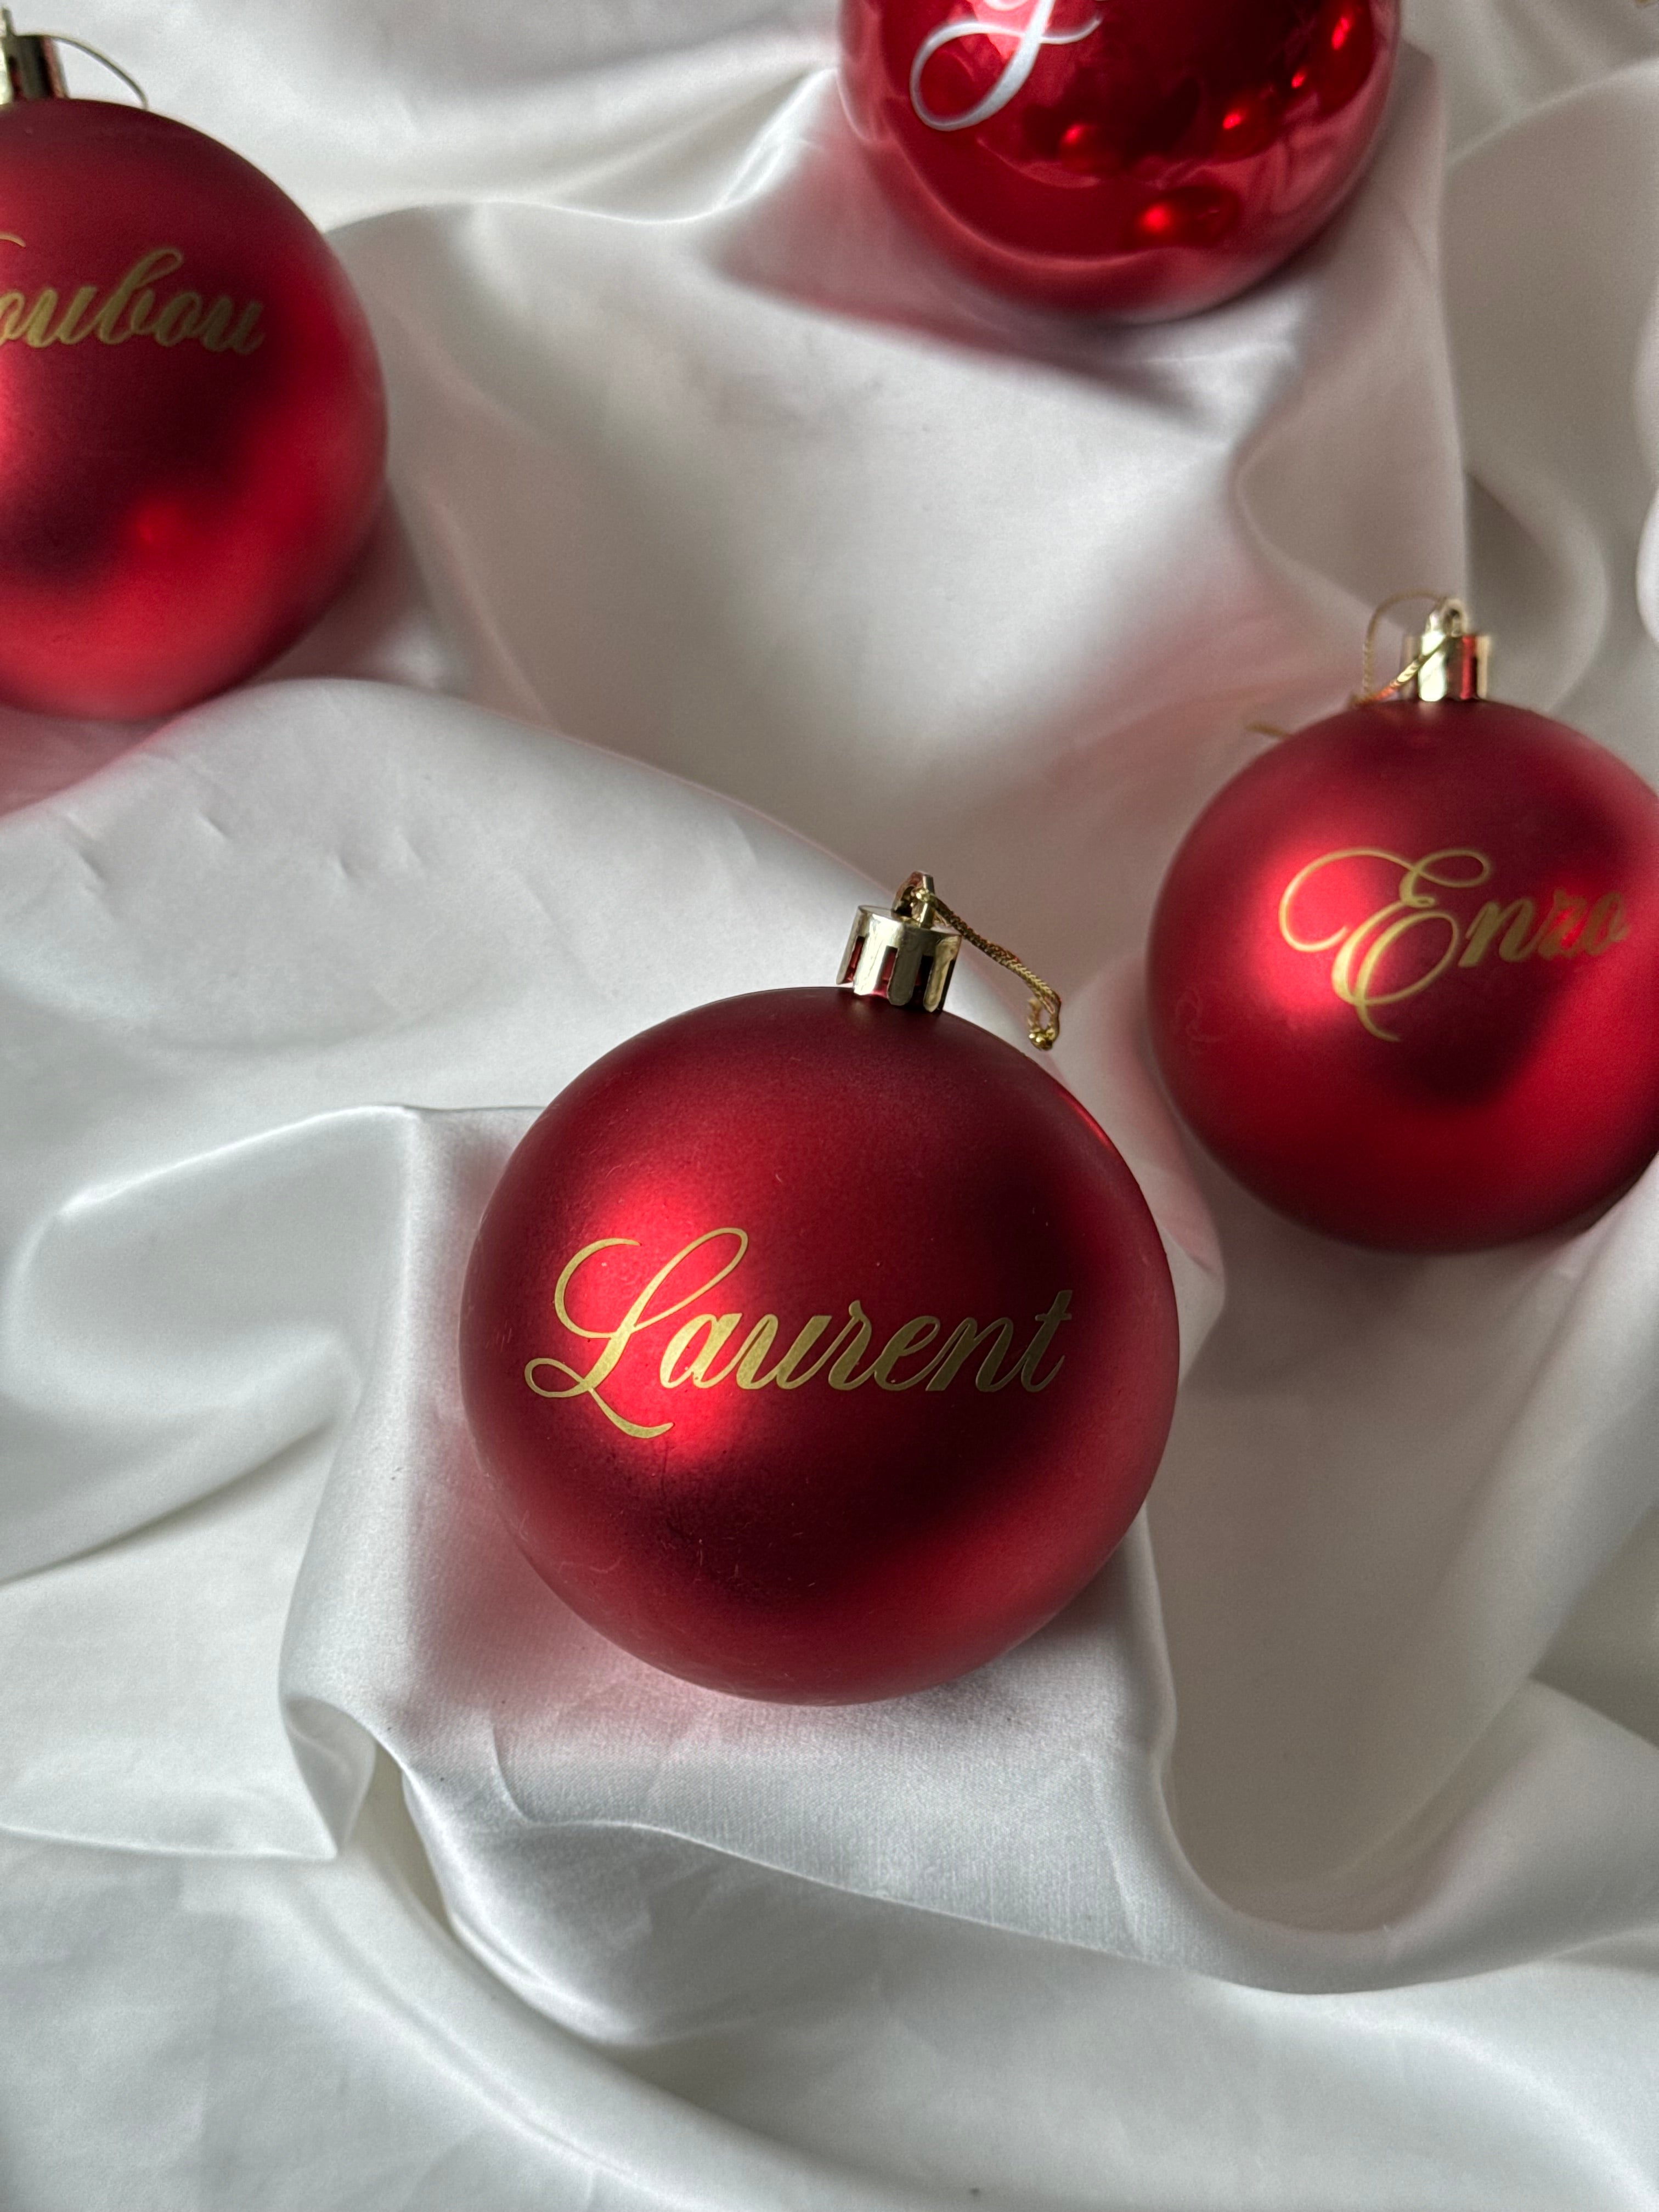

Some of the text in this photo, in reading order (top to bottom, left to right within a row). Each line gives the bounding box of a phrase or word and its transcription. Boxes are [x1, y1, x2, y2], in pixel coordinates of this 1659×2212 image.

[0, 232, 265, 355] oubou
[1278, 846, 1630, 1042] Enzo
[523, 1227, 1074, 1439] Laurent
